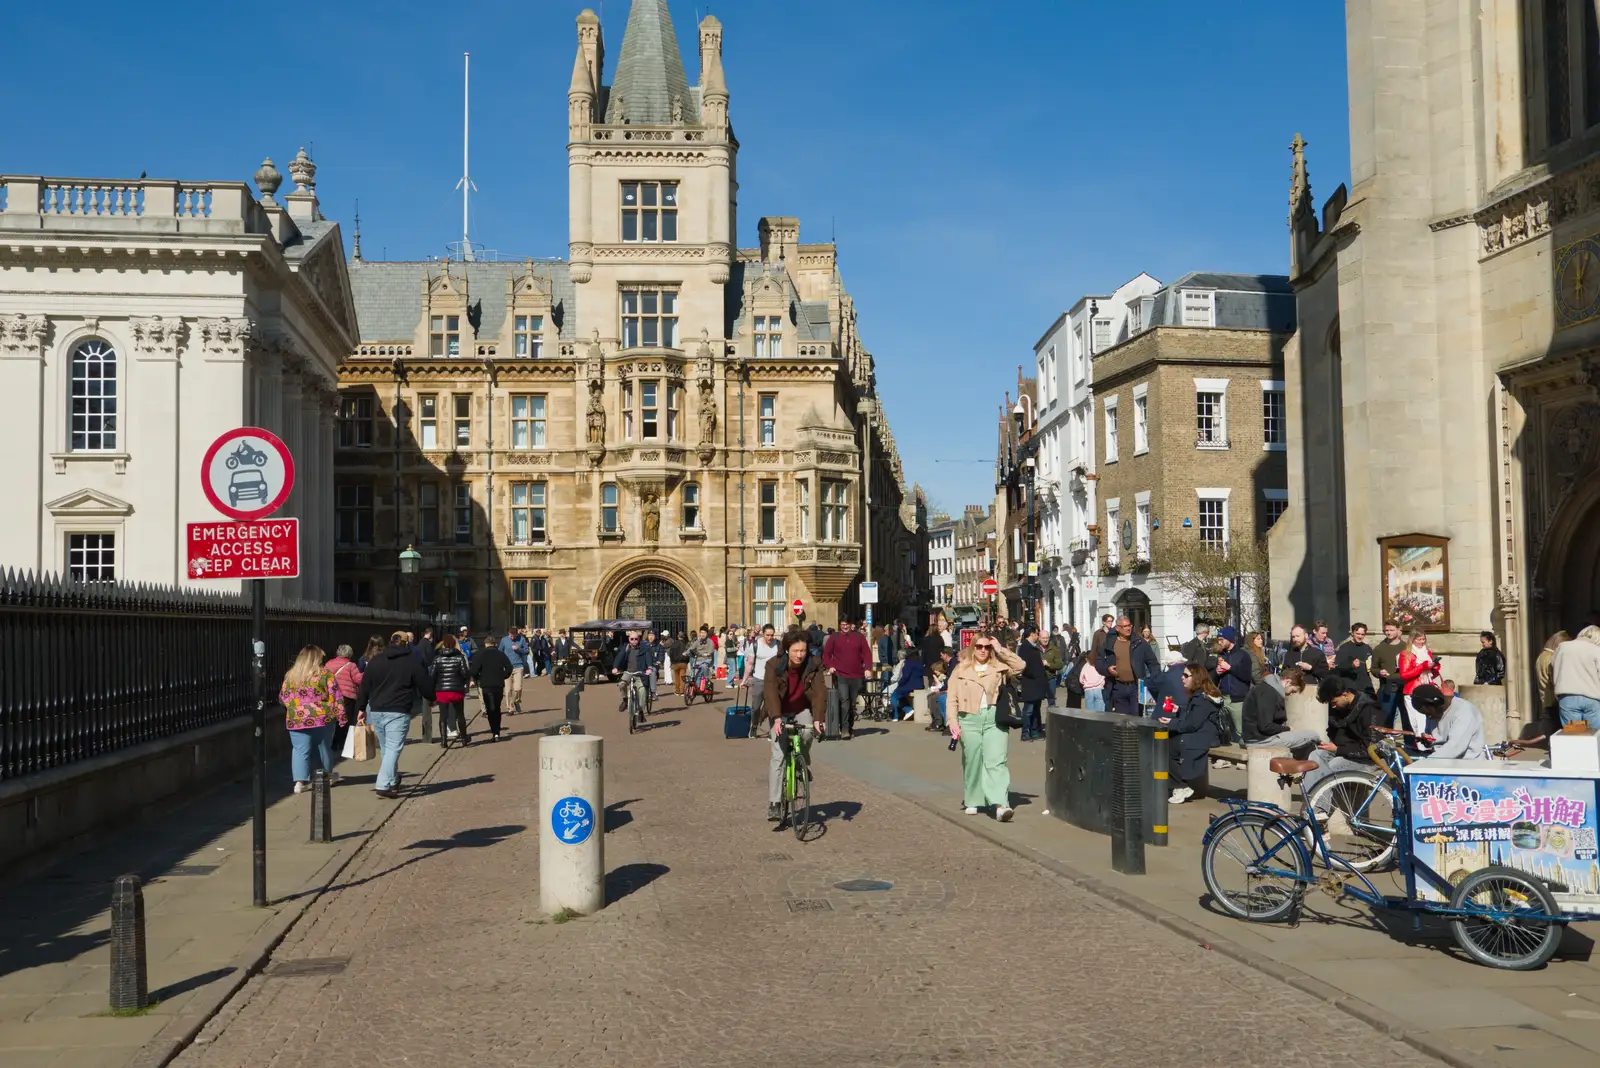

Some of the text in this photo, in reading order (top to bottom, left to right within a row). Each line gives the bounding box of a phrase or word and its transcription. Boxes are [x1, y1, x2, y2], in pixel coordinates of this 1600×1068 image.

[192, 525, 292, 541] EMERGENCY
[211, 541, 273, 556] ACCESS
[192, 557, 291, 573] EEP CLEAR
[1416, 782, 1457, 802] 剑桥
[1422, 795, 1585, 827] 中文漫步讲解
[1456, 827, 1511, 841] 深度讲解
